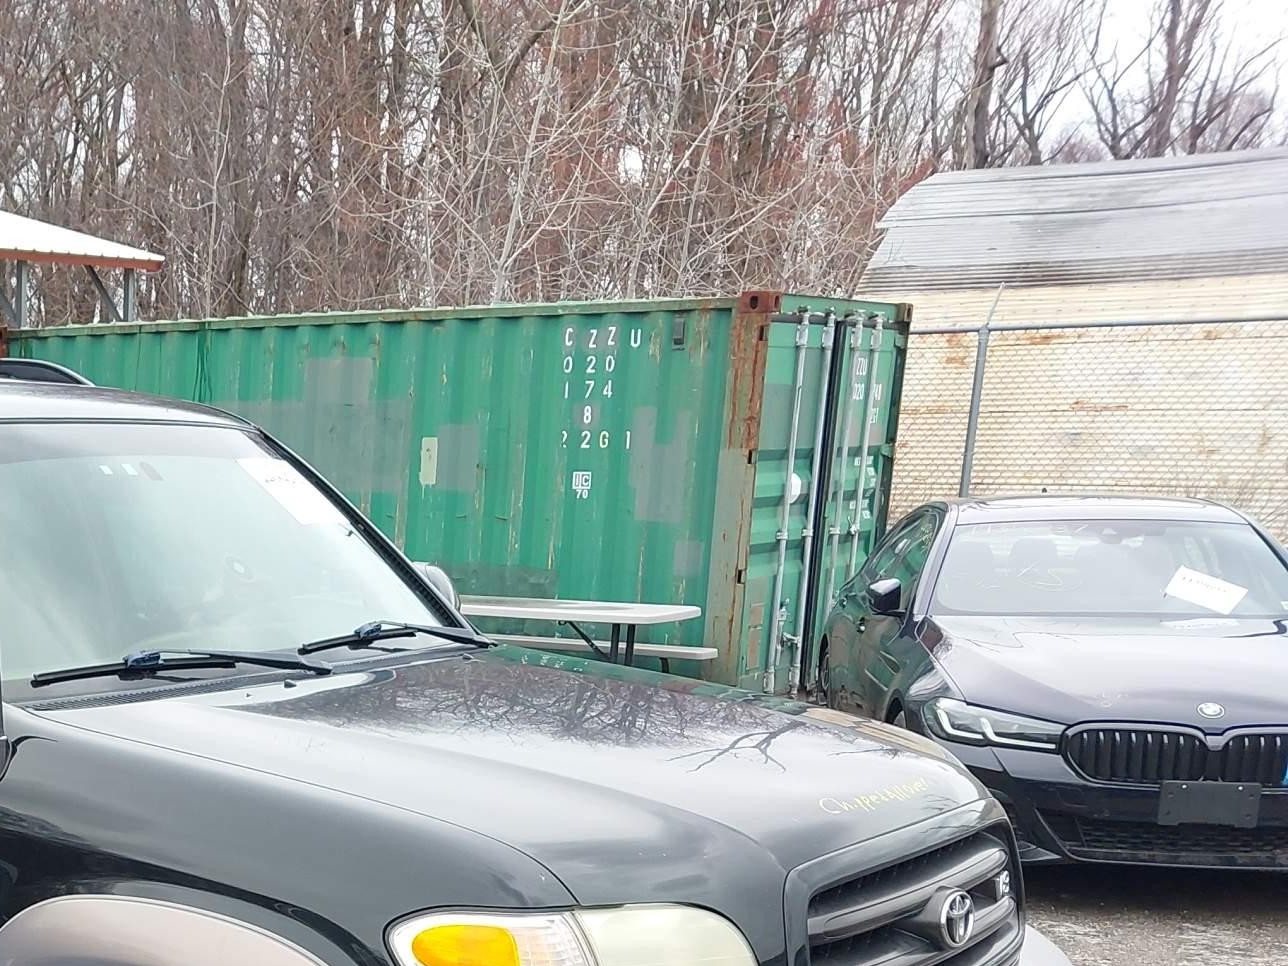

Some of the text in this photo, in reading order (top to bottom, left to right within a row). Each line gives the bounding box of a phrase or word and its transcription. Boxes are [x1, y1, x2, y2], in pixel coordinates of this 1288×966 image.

[563, 355, 616, 374] 020
[564, 380, 613, 399] 174
[583, 405, 592, 424] 8
